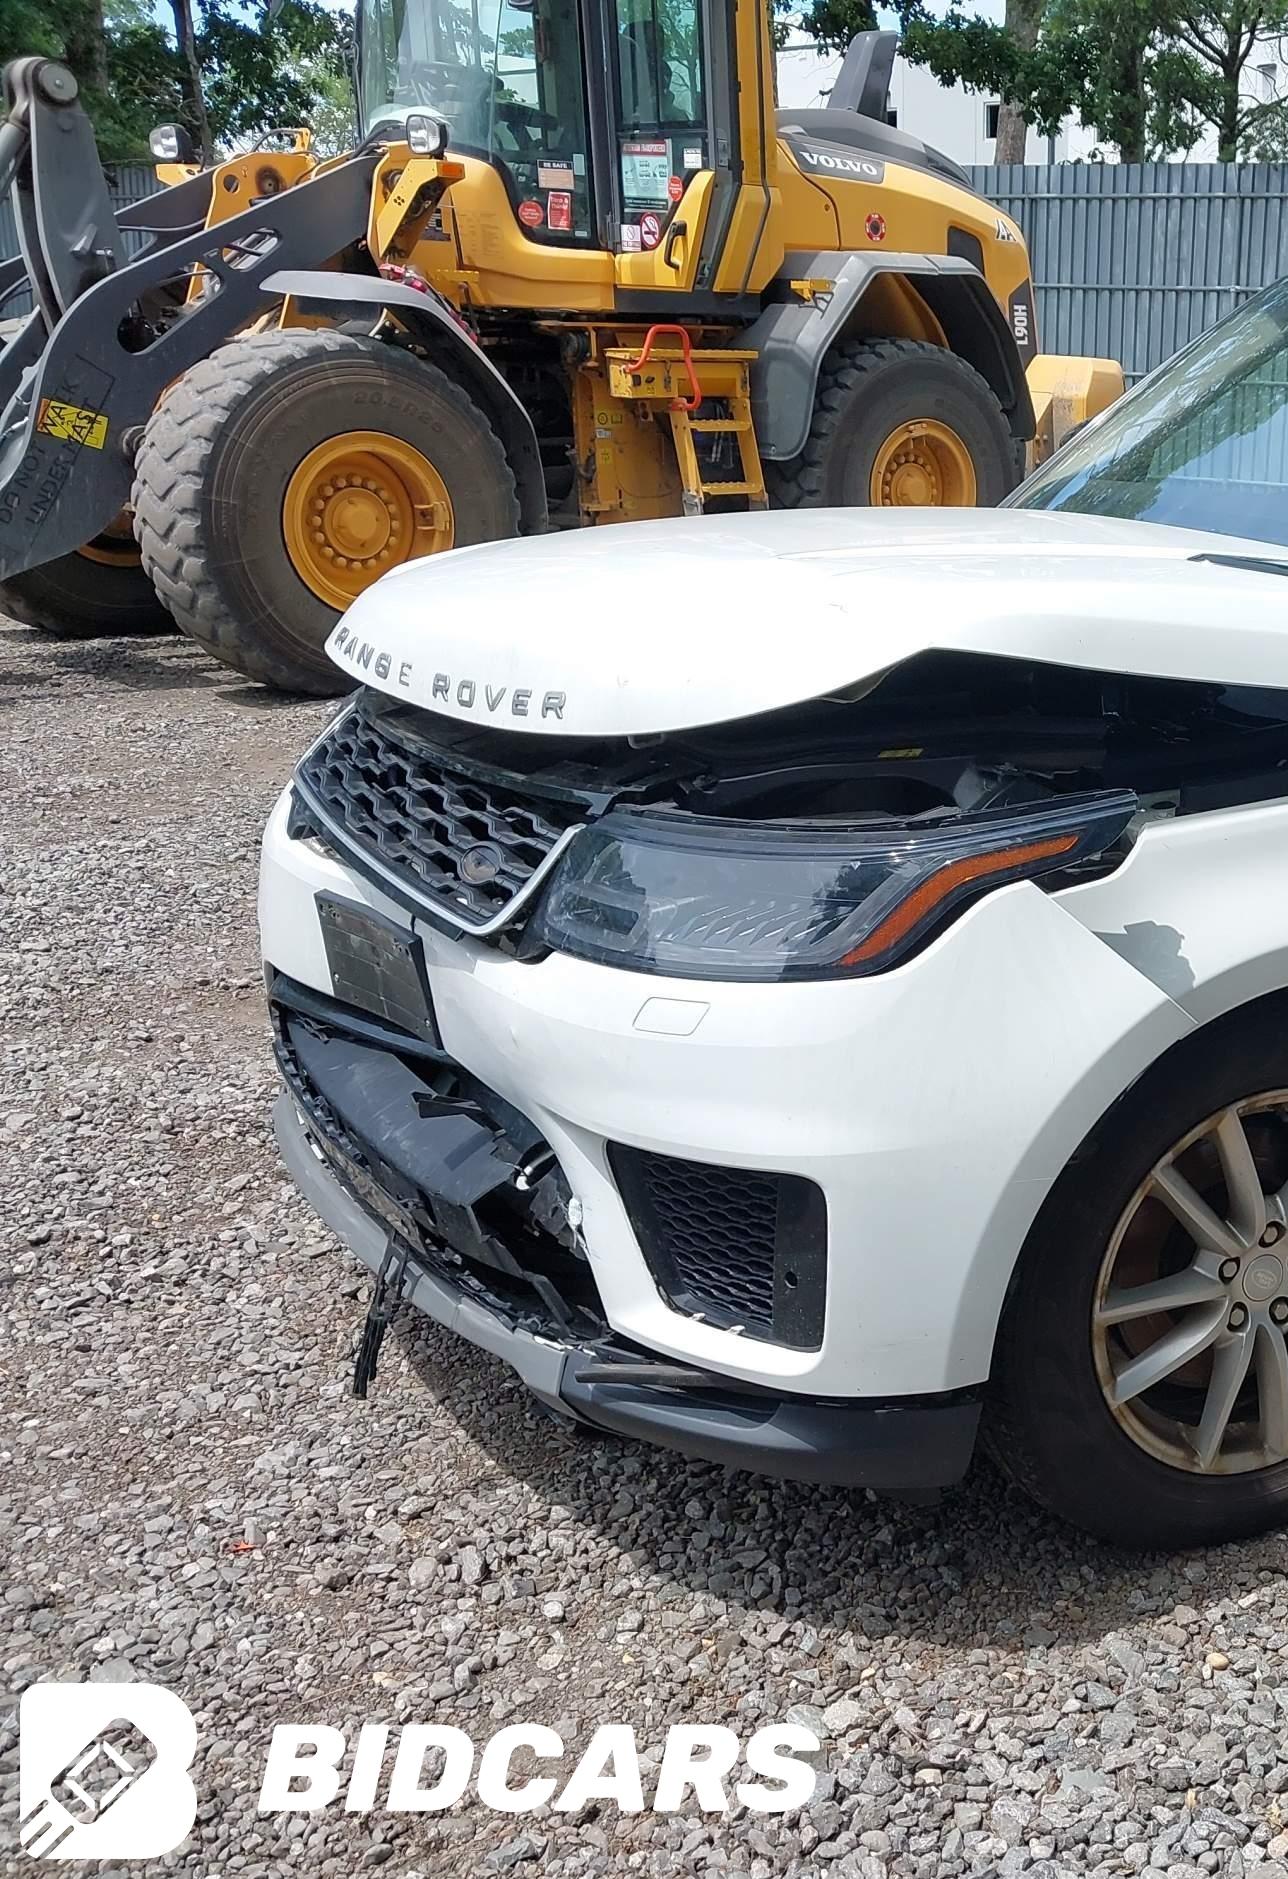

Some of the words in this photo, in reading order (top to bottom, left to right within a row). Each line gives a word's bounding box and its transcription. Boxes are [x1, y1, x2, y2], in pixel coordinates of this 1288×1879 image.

[799, 151, 878, 176] VOLVO
[1013, 304, 1029, 346] L90H
[0, 491, 20, 525] DO
[14, 440, 47, 490] NOT
[25, 457, 72, 526] UNDER
[334, 626, 413, 687] RANGE
[432, 672, 567, 720] ROVER
